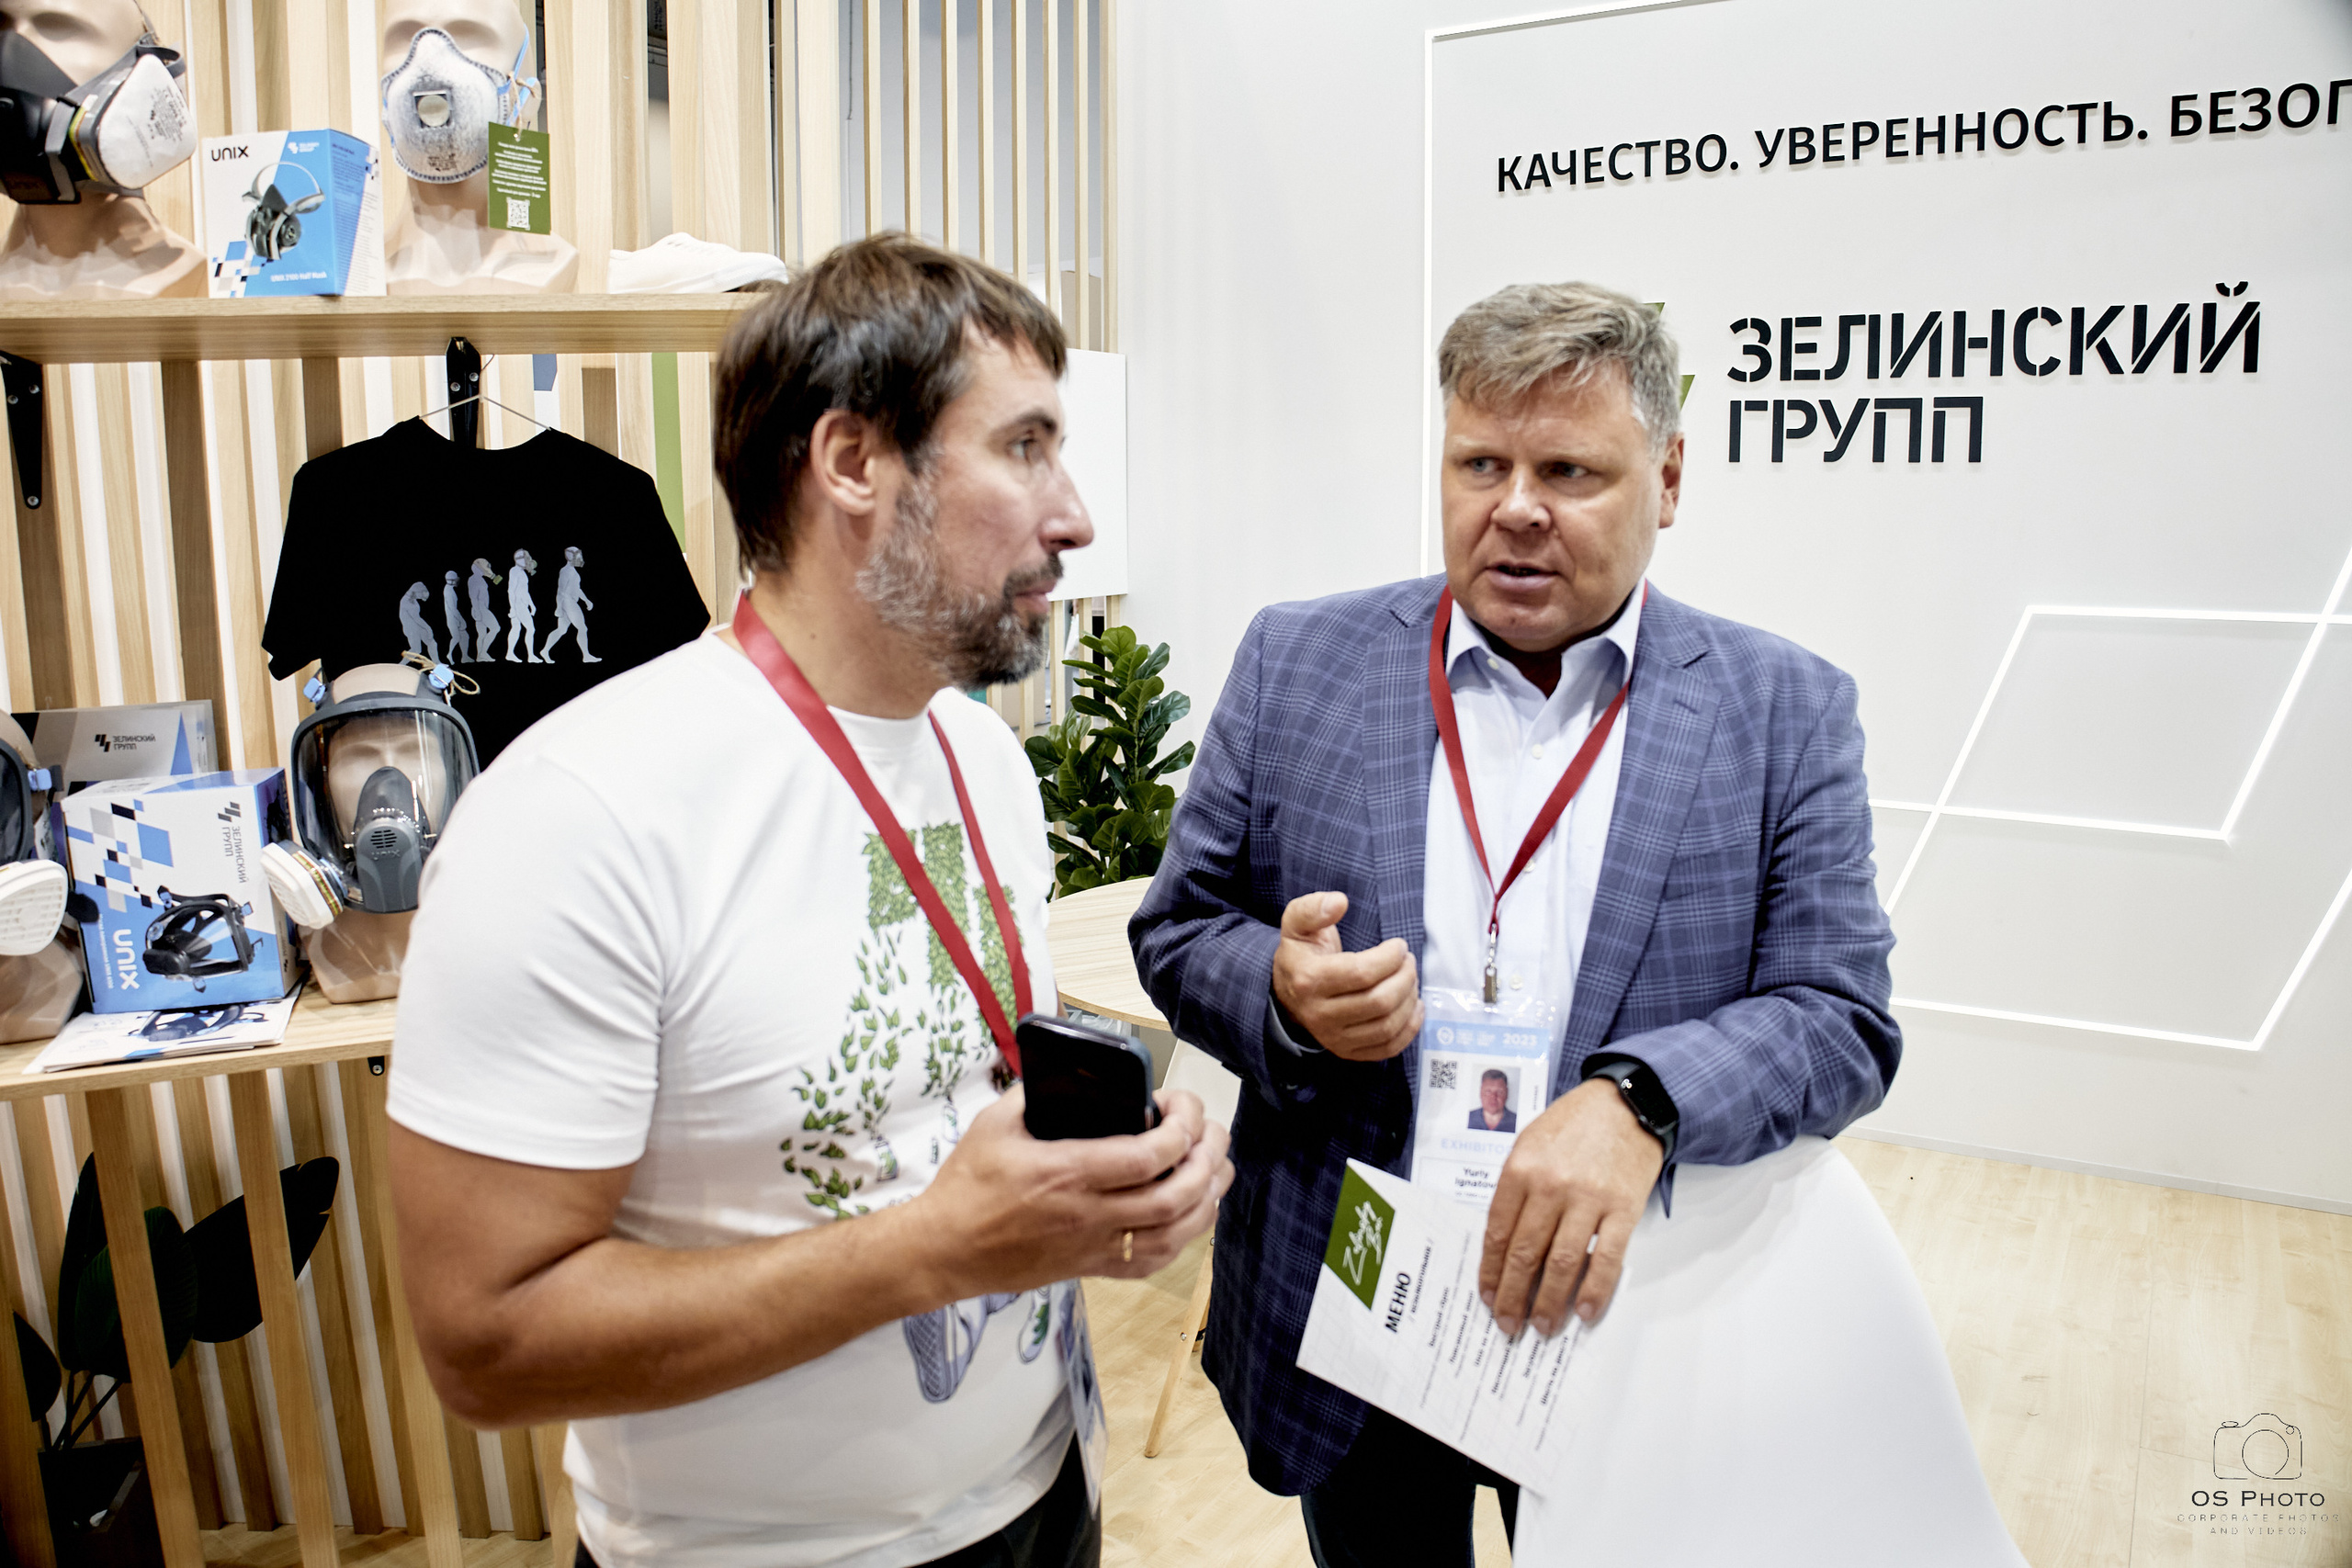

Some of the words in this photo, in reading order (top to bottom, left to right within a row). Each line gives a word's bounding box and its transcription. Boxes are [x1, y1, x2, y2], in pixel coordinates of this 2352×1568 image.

[1498, 134, 1738, 193] КАЧЕСТВО.
[1755, 101, 2148, 168] УВЕРЕННОСТЬ.
[1727, 281, 2261, 383] ЗЕЛИНСКИЙ
[1728, 396, 1984, 463] ГРУПП
[113, 734, 156, 743] ЗЕЛИНСКИЙ
[222, 826, 234, 857] ГРУПП
[232, 826, 250, 884] ЗЕЛИНСКИЙ
[1503, 1032, 1538, 1046] 2023
[1385, 1272, 1412, 1333] МЕНЮ
